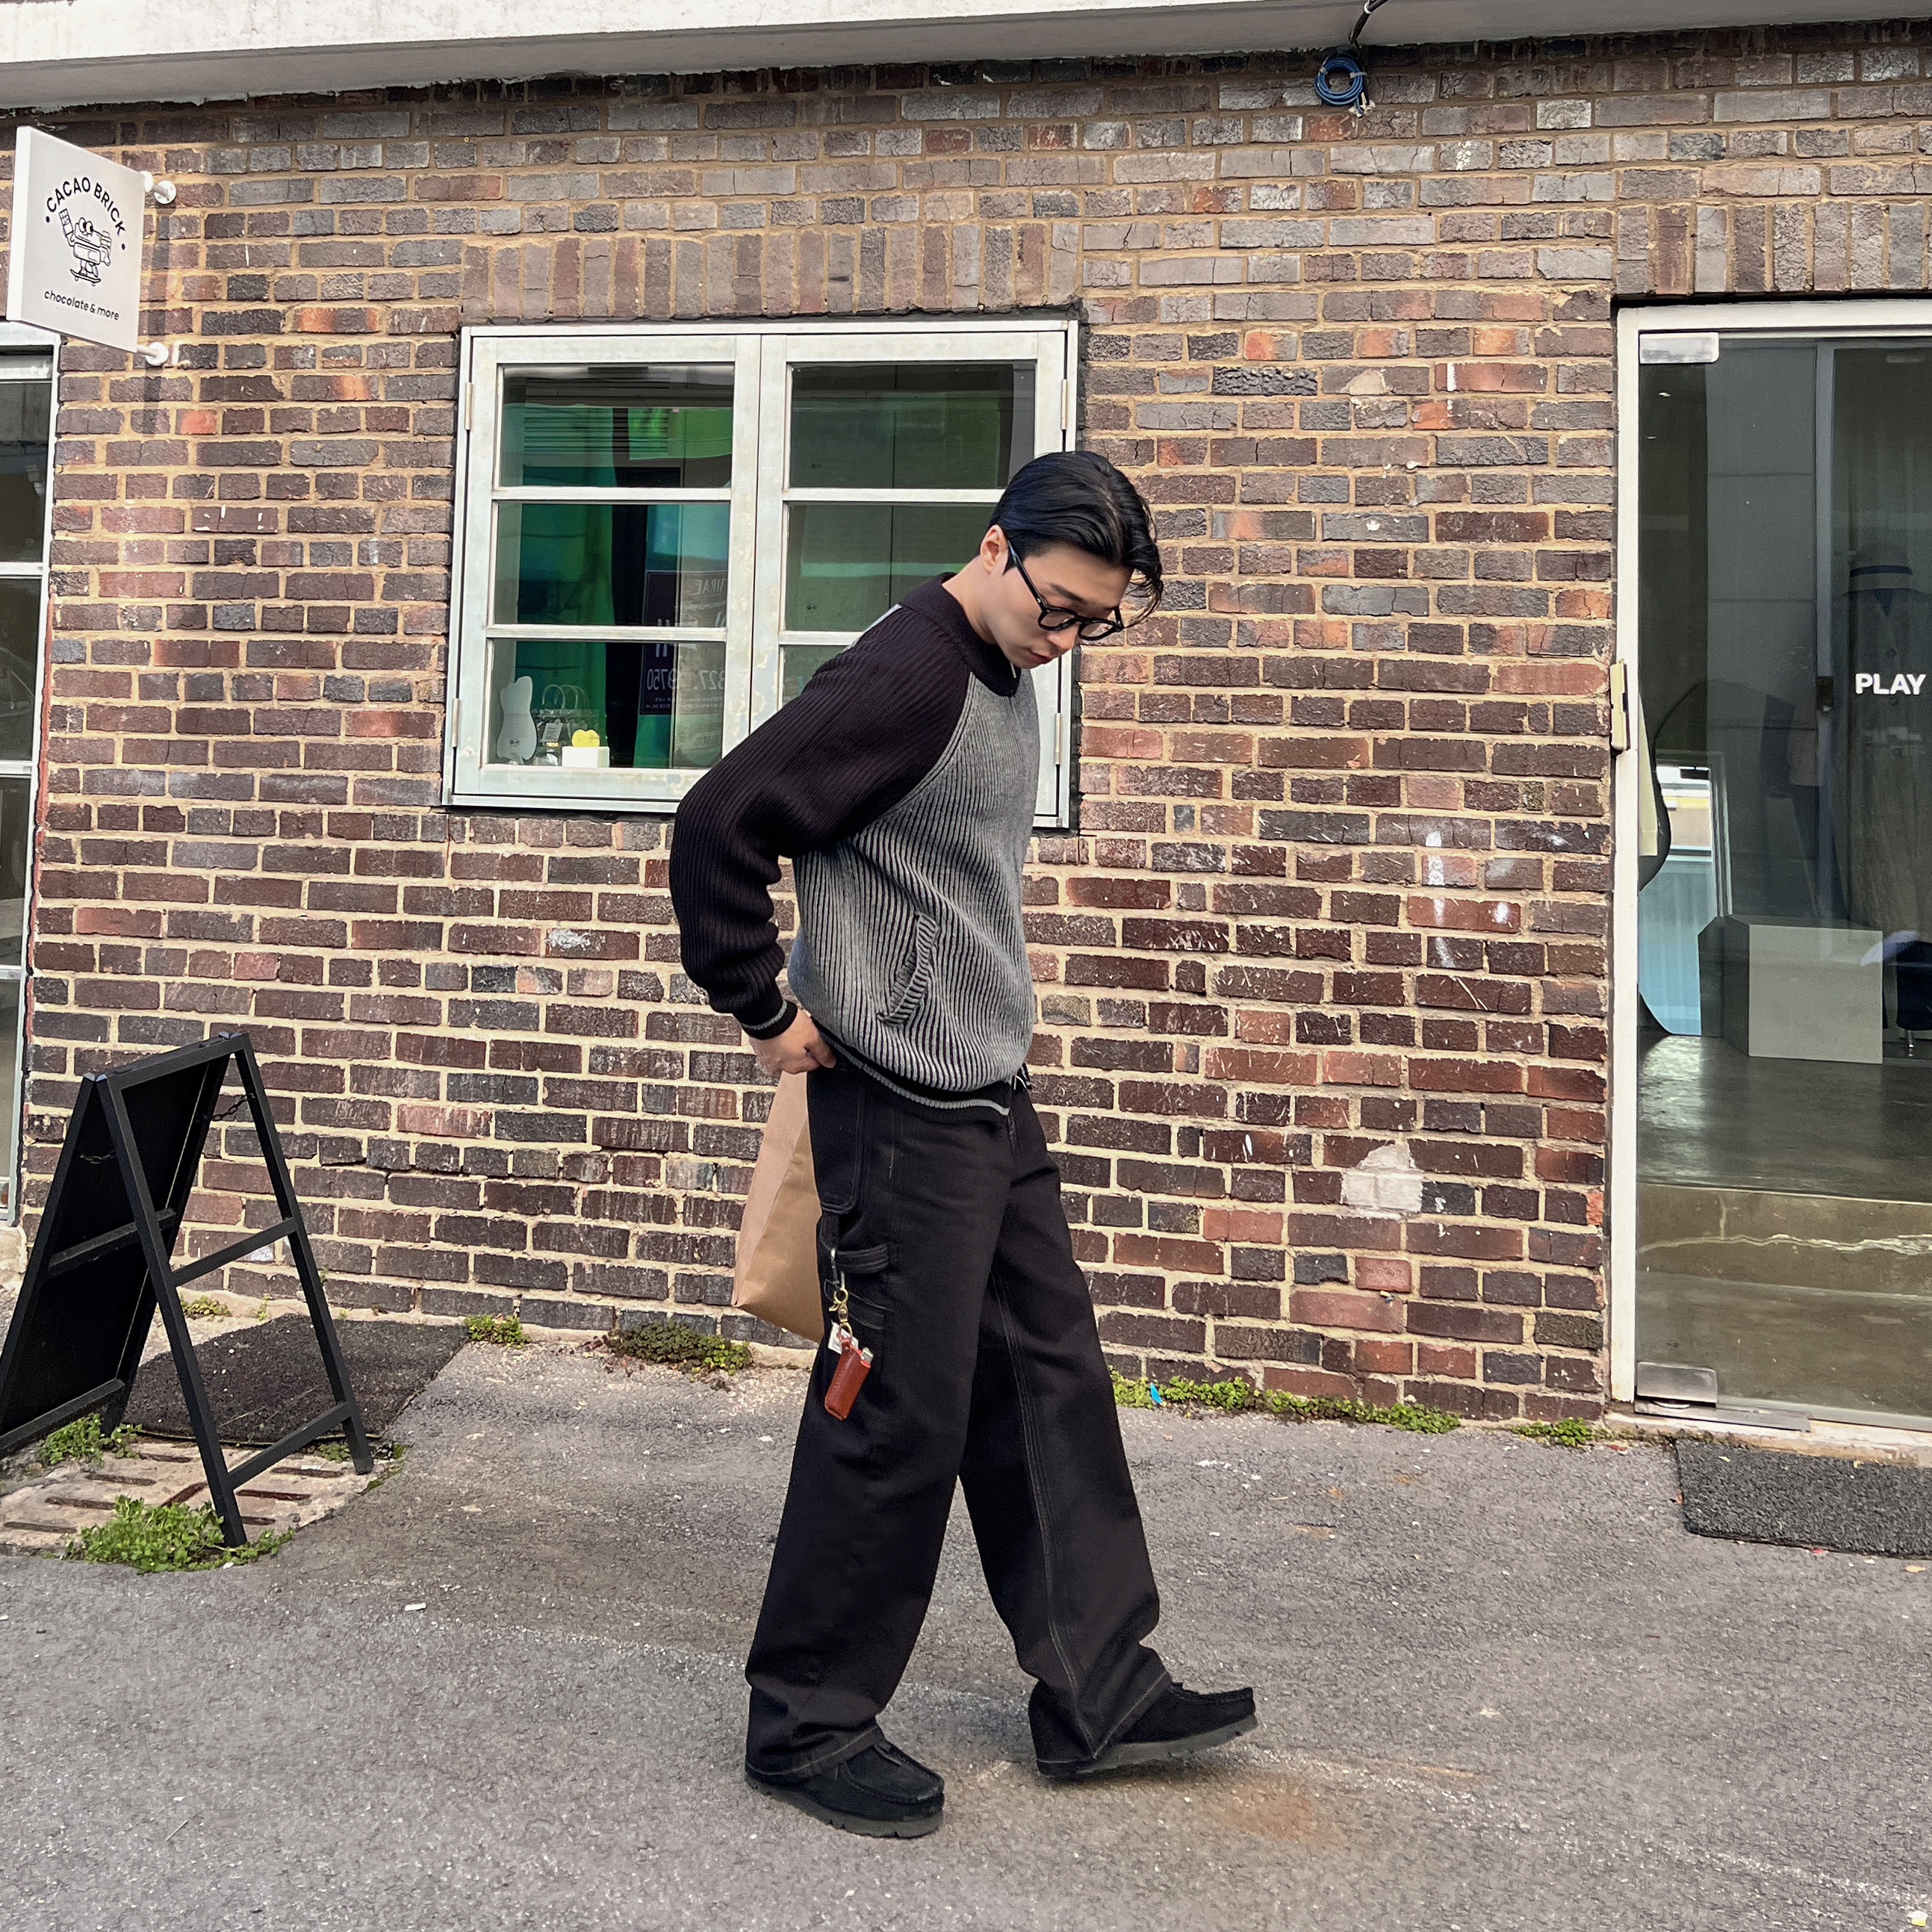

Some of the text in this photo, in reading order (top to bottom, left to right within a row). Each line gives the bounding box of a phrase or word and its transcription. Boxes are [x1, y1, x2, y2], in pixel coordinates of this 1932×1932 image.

[46, 176, 126, 237] CACAO BRICK
[44, 290, 119, 320] chocolate & more
[1855, 673, 1927, 695] PLAY
